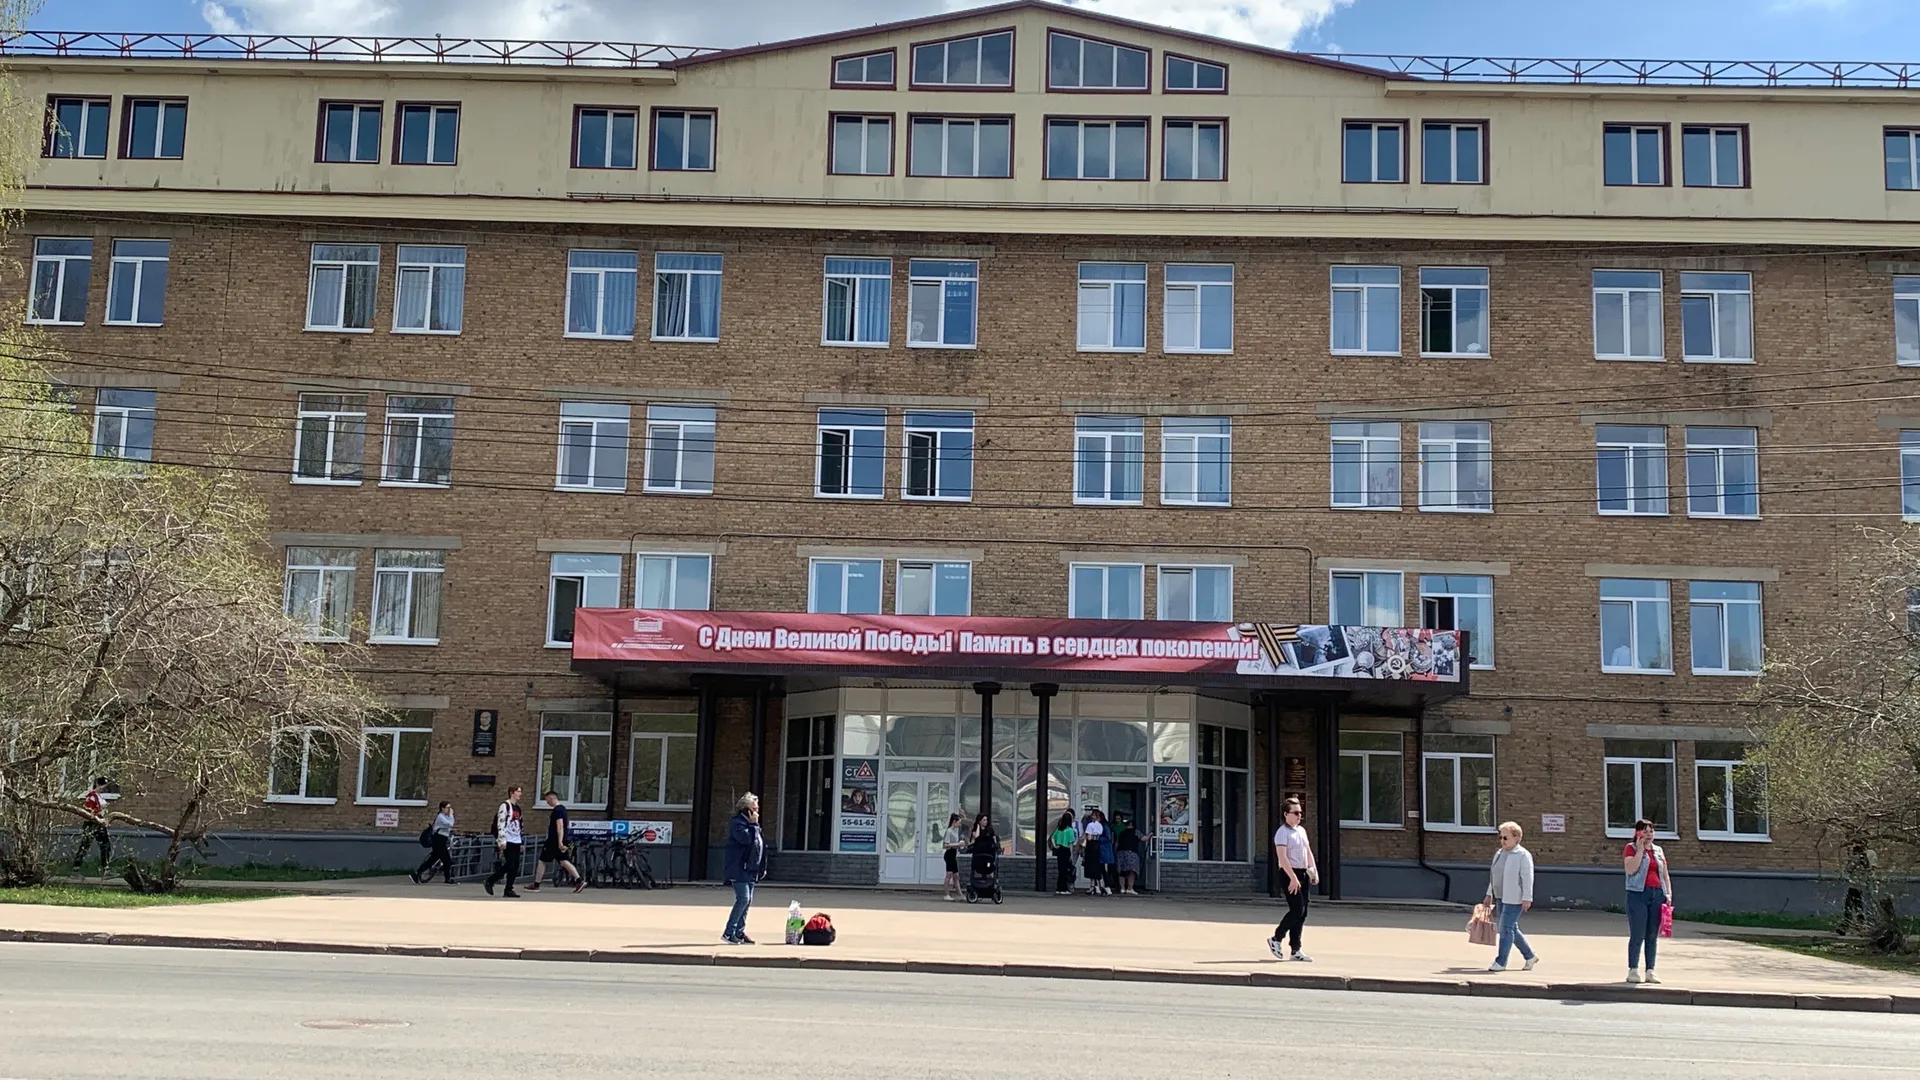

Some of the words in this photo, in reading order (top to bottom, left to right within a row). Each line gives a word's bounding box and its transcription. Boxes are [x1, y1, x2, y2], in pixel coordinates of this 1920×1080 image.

[698, 626, 713, 647] С
[715, 627, 772, 651] Днем
[774, 628, 862, 650] Великой
[865, 630, 954, 655] Победы!
[959, 632, 1034, 655] Память
[1037, 637, 1050, 655] в
[1053, 637, 1138, 658] сердцах
[1141, 637, 1260, 659] поколений!
